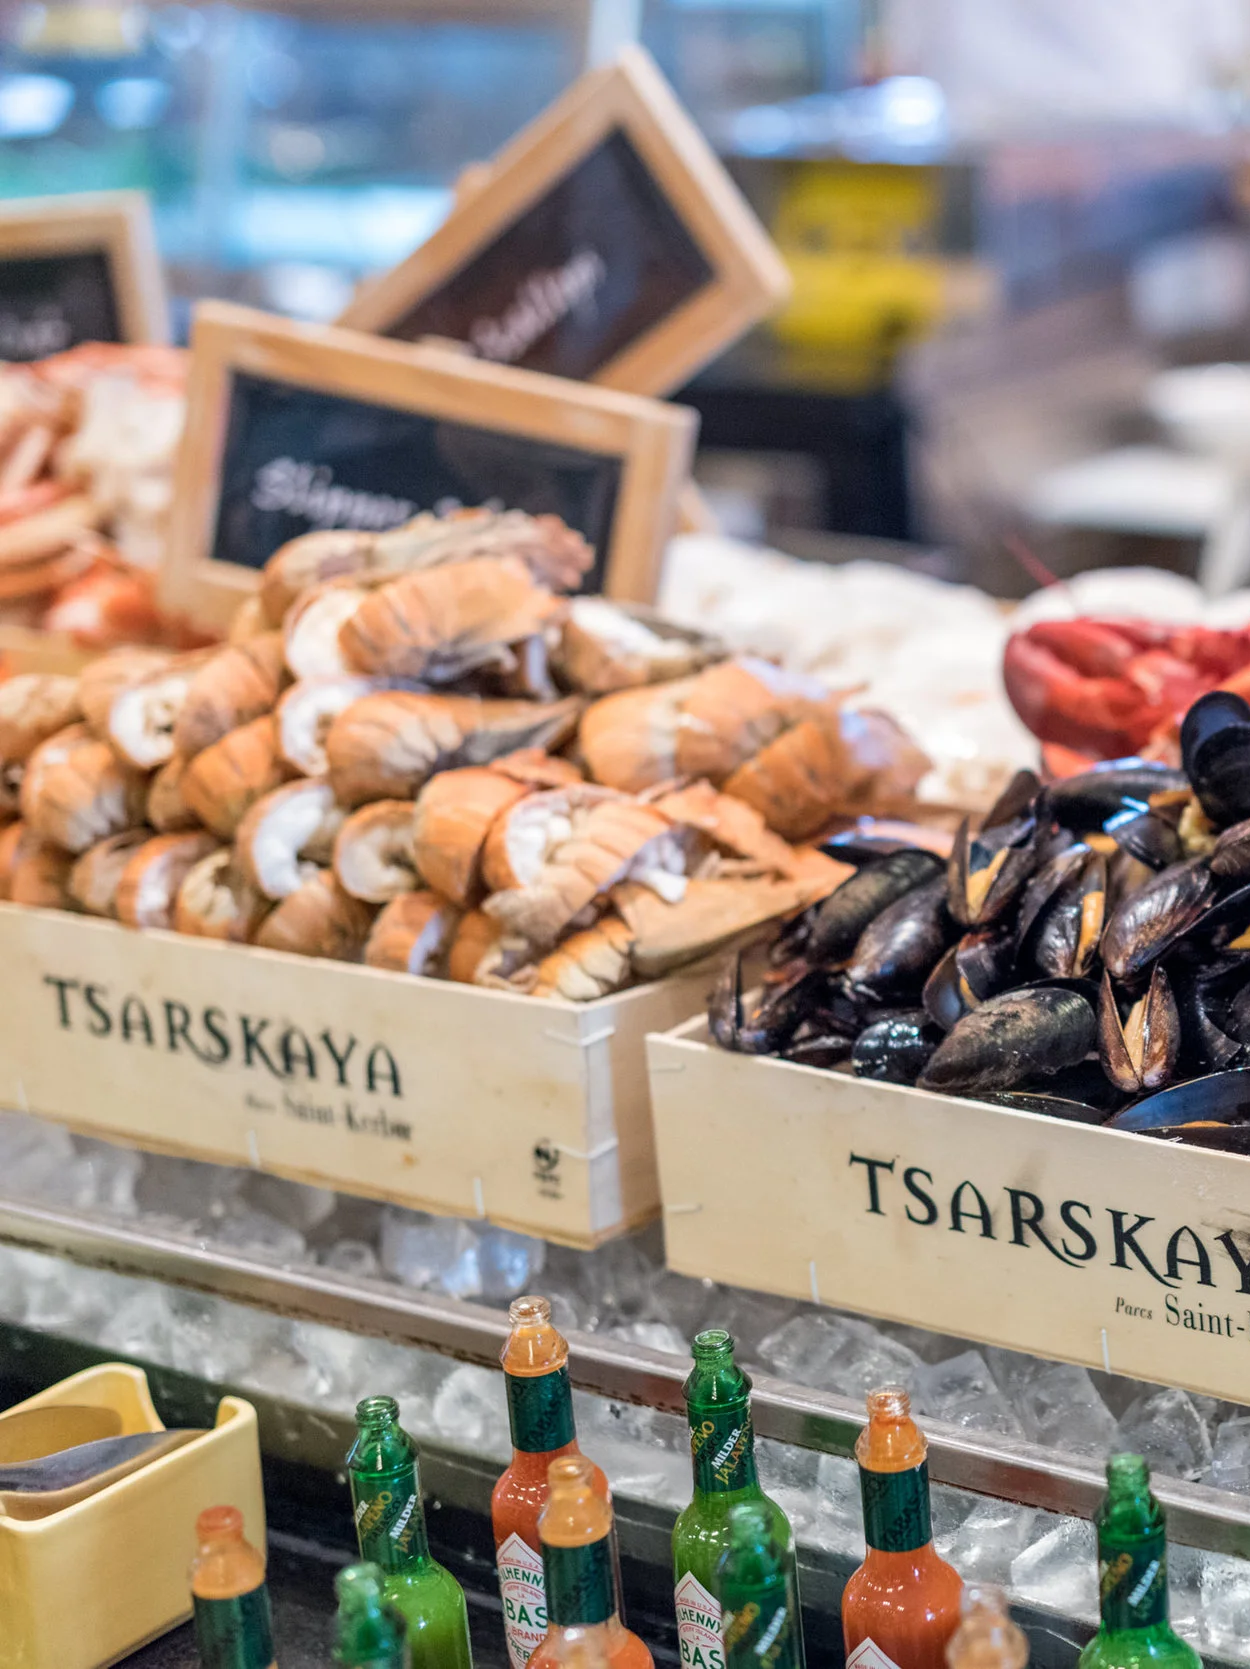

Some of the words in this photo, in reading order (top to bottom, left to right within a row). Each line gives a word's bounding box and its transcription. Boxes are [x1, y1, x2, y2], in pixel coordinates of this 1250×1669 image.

[43, 974, 405, 1099] TSARSKAYA
[1114, 1296, 1154, 1321] Parcs
[711, 1423, 742, 1470] MILDER
[389, 1494, 418, 1540] MILDER
